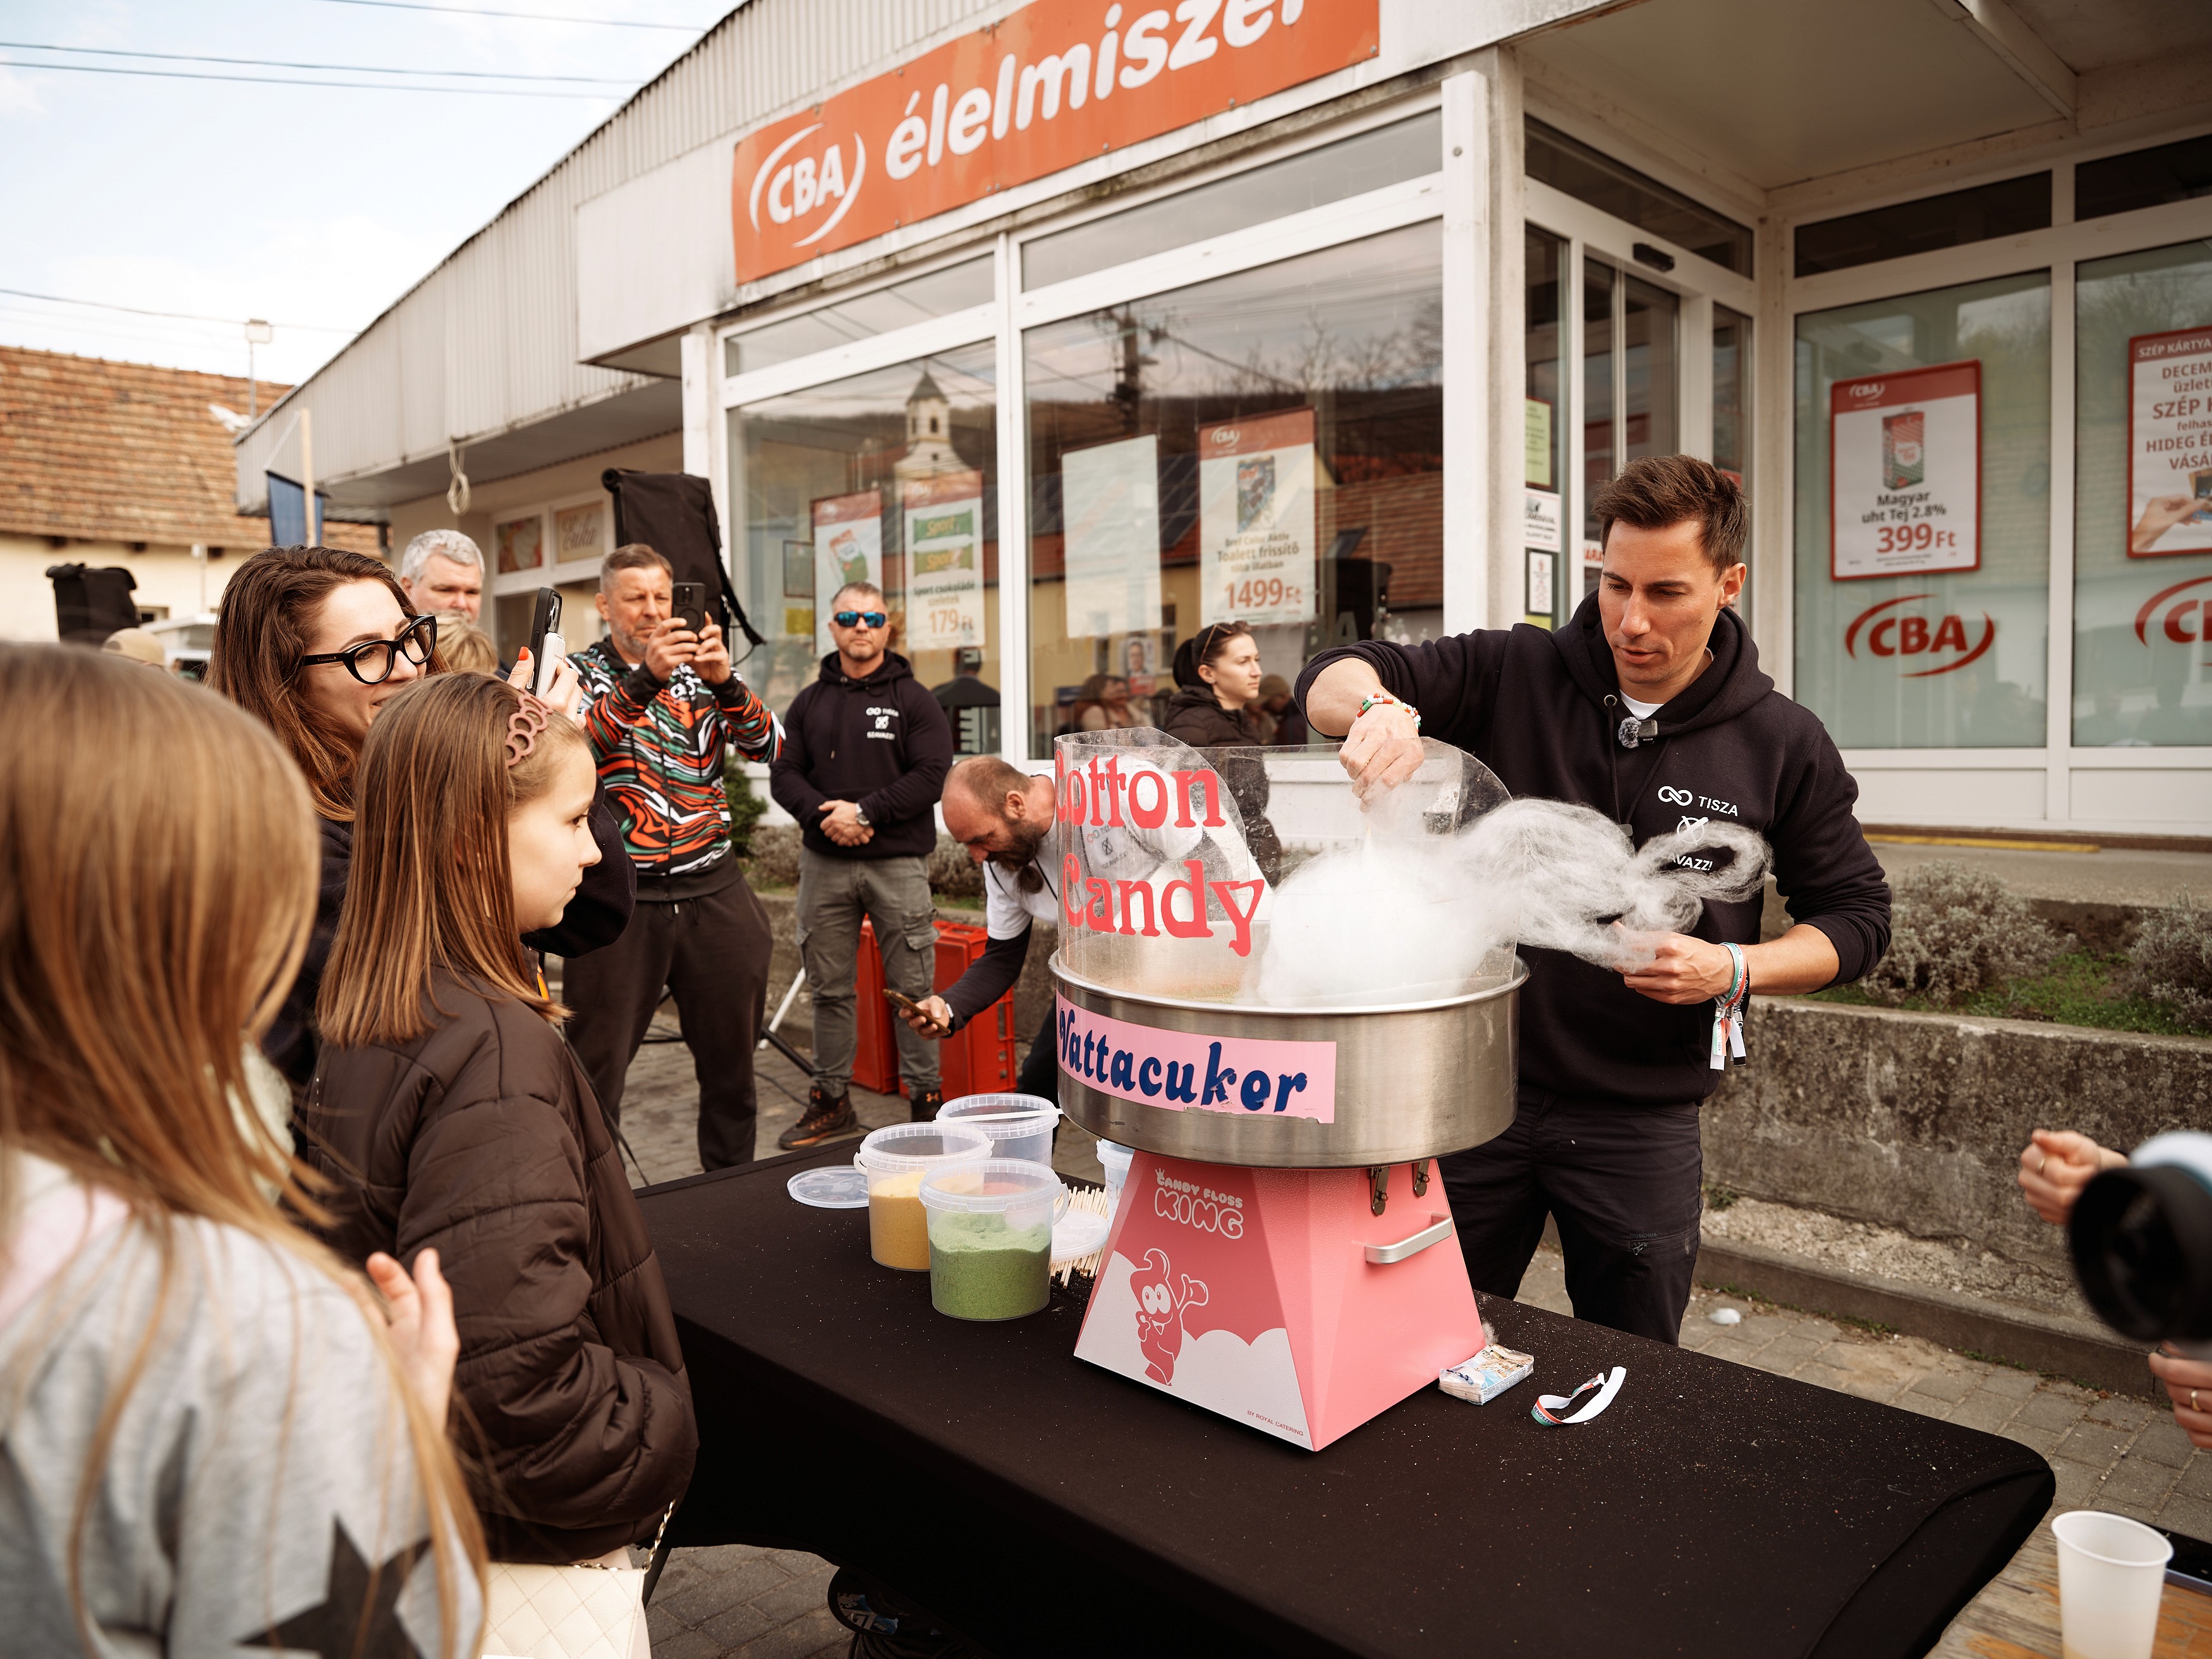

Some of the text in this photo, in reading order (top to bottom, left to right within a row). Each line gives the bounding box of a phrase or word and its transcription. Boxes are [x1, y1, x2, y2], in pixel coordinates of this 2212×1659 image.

[768, 143, 846, 224] CBA
[2138, 338, 2211, 358] SZÉP KÁRTYA
[2173, 378, 2212, 394] üzlet
[2153, 396, 2201, 420] SZÉP
[2146, 434, 2196, 453] HIDEG
[2169, 451, 2212, 470] VÁSÁ
[1876, 491, 1931, 507] Magyar
[1861, 508, 1886, 524] uht
[1890, 507, 1909, 523] Tej
[1876, 523, 1957, 554] 399 Ft
[1224, 578, 1284, 610] 1499
[928, 608, 959, 634] 179
[1868, 615, 1968, 657] CBA
[1055, 748, 1227, 830] Cotton
[1698, 796, 1738, 817] TISZA
[1662, 852, 1713, 871] AVAZZ!
[1062, 853, 1265, 957] Candy
[1059, 1007, 1308, 1113] Vattacukor
[1157, 1173, 1243, 1208] CANDY FLOSS
[1155, 1187, 1244, 1239] KING
[1256, 1414, 1274, 1425] ROYAL
[1275, 1421, 1304, 1437] CATERING
